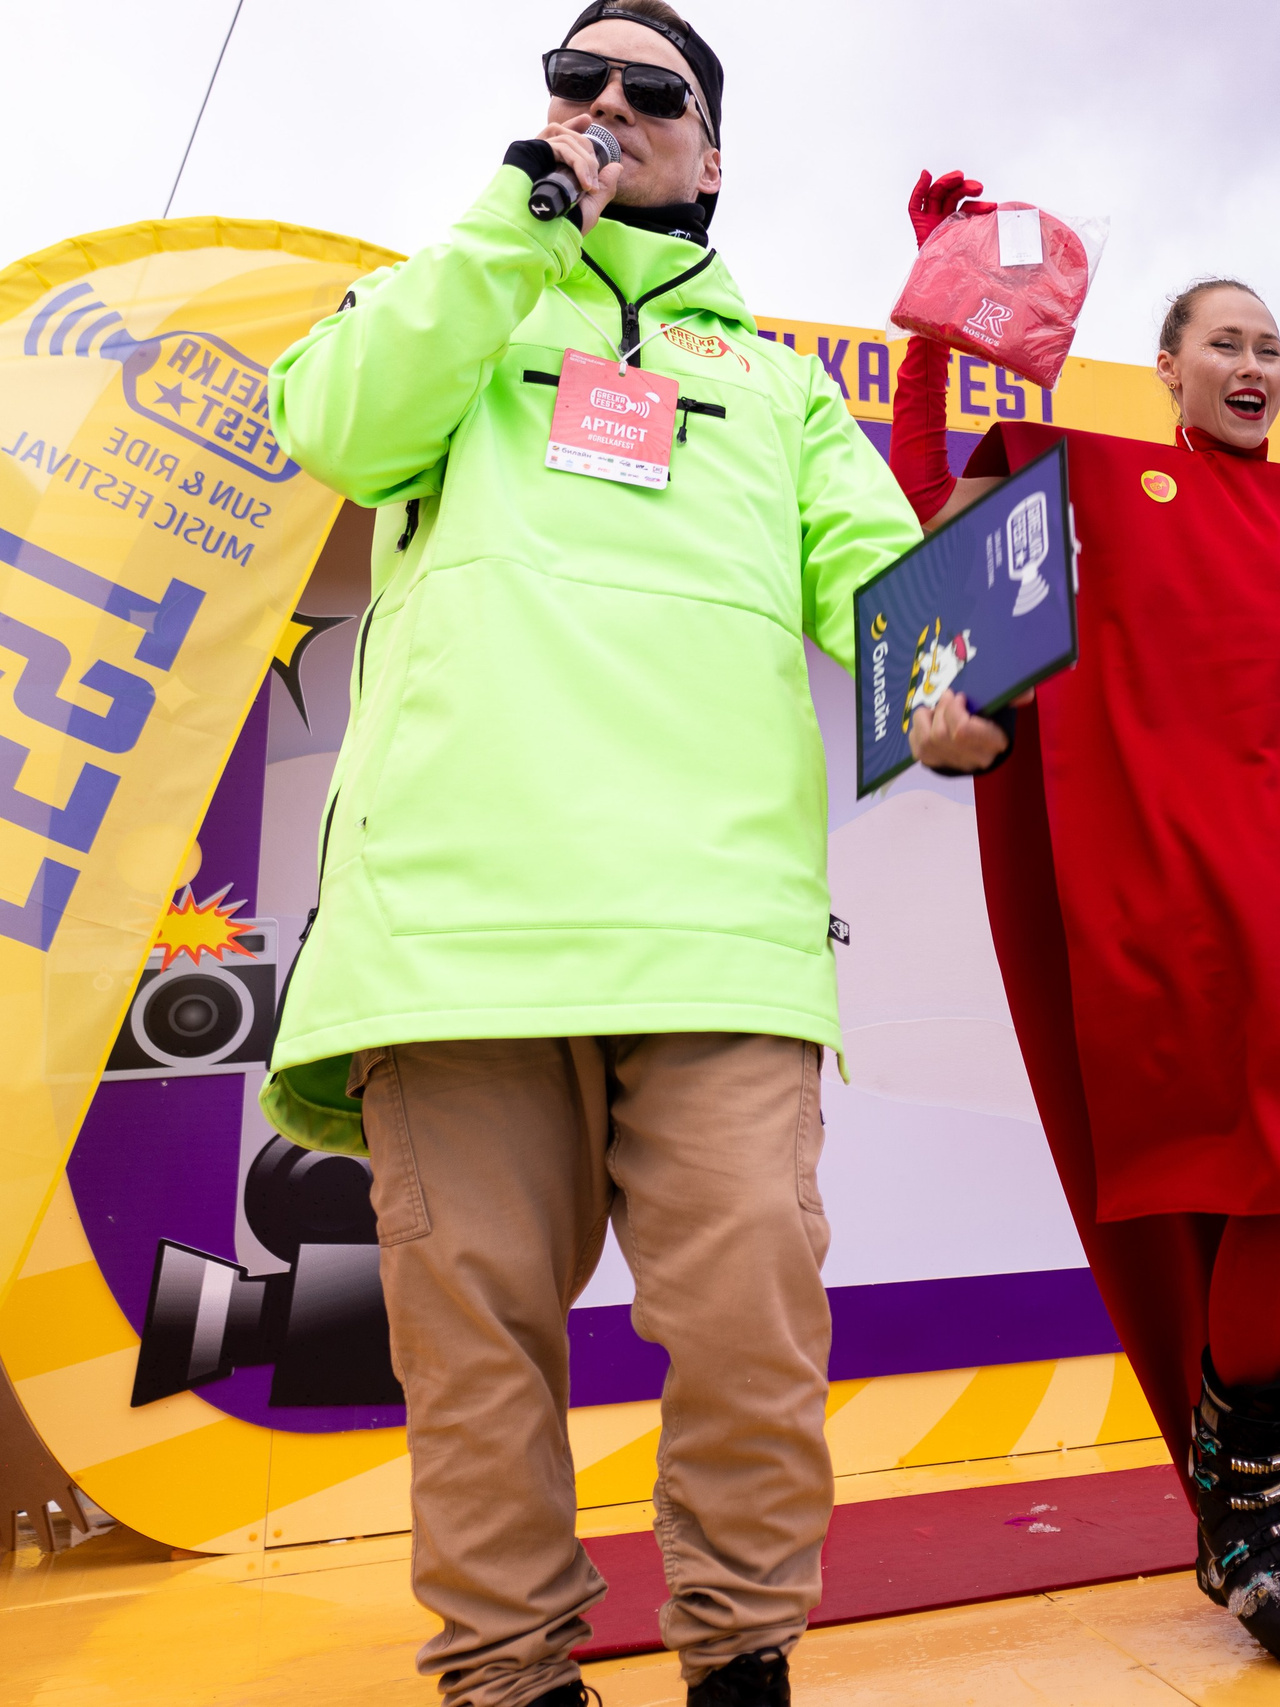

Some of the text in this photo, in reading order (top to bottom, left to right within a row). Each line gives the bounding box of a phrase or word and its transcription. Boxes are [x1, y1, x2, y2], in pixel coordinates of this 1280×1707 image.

[669, 328, 715, 347] GRELKA
[671, 335, 701, 353] FEST
[595, 397, 616, 410] FEST
[596, 391, 627, 404] GRELKA
[580, 415, 649, 443] АРТИСТ
[587, 433, 635, 450] #GRELKAFEST
[872, 641, 890, 743] билайн
